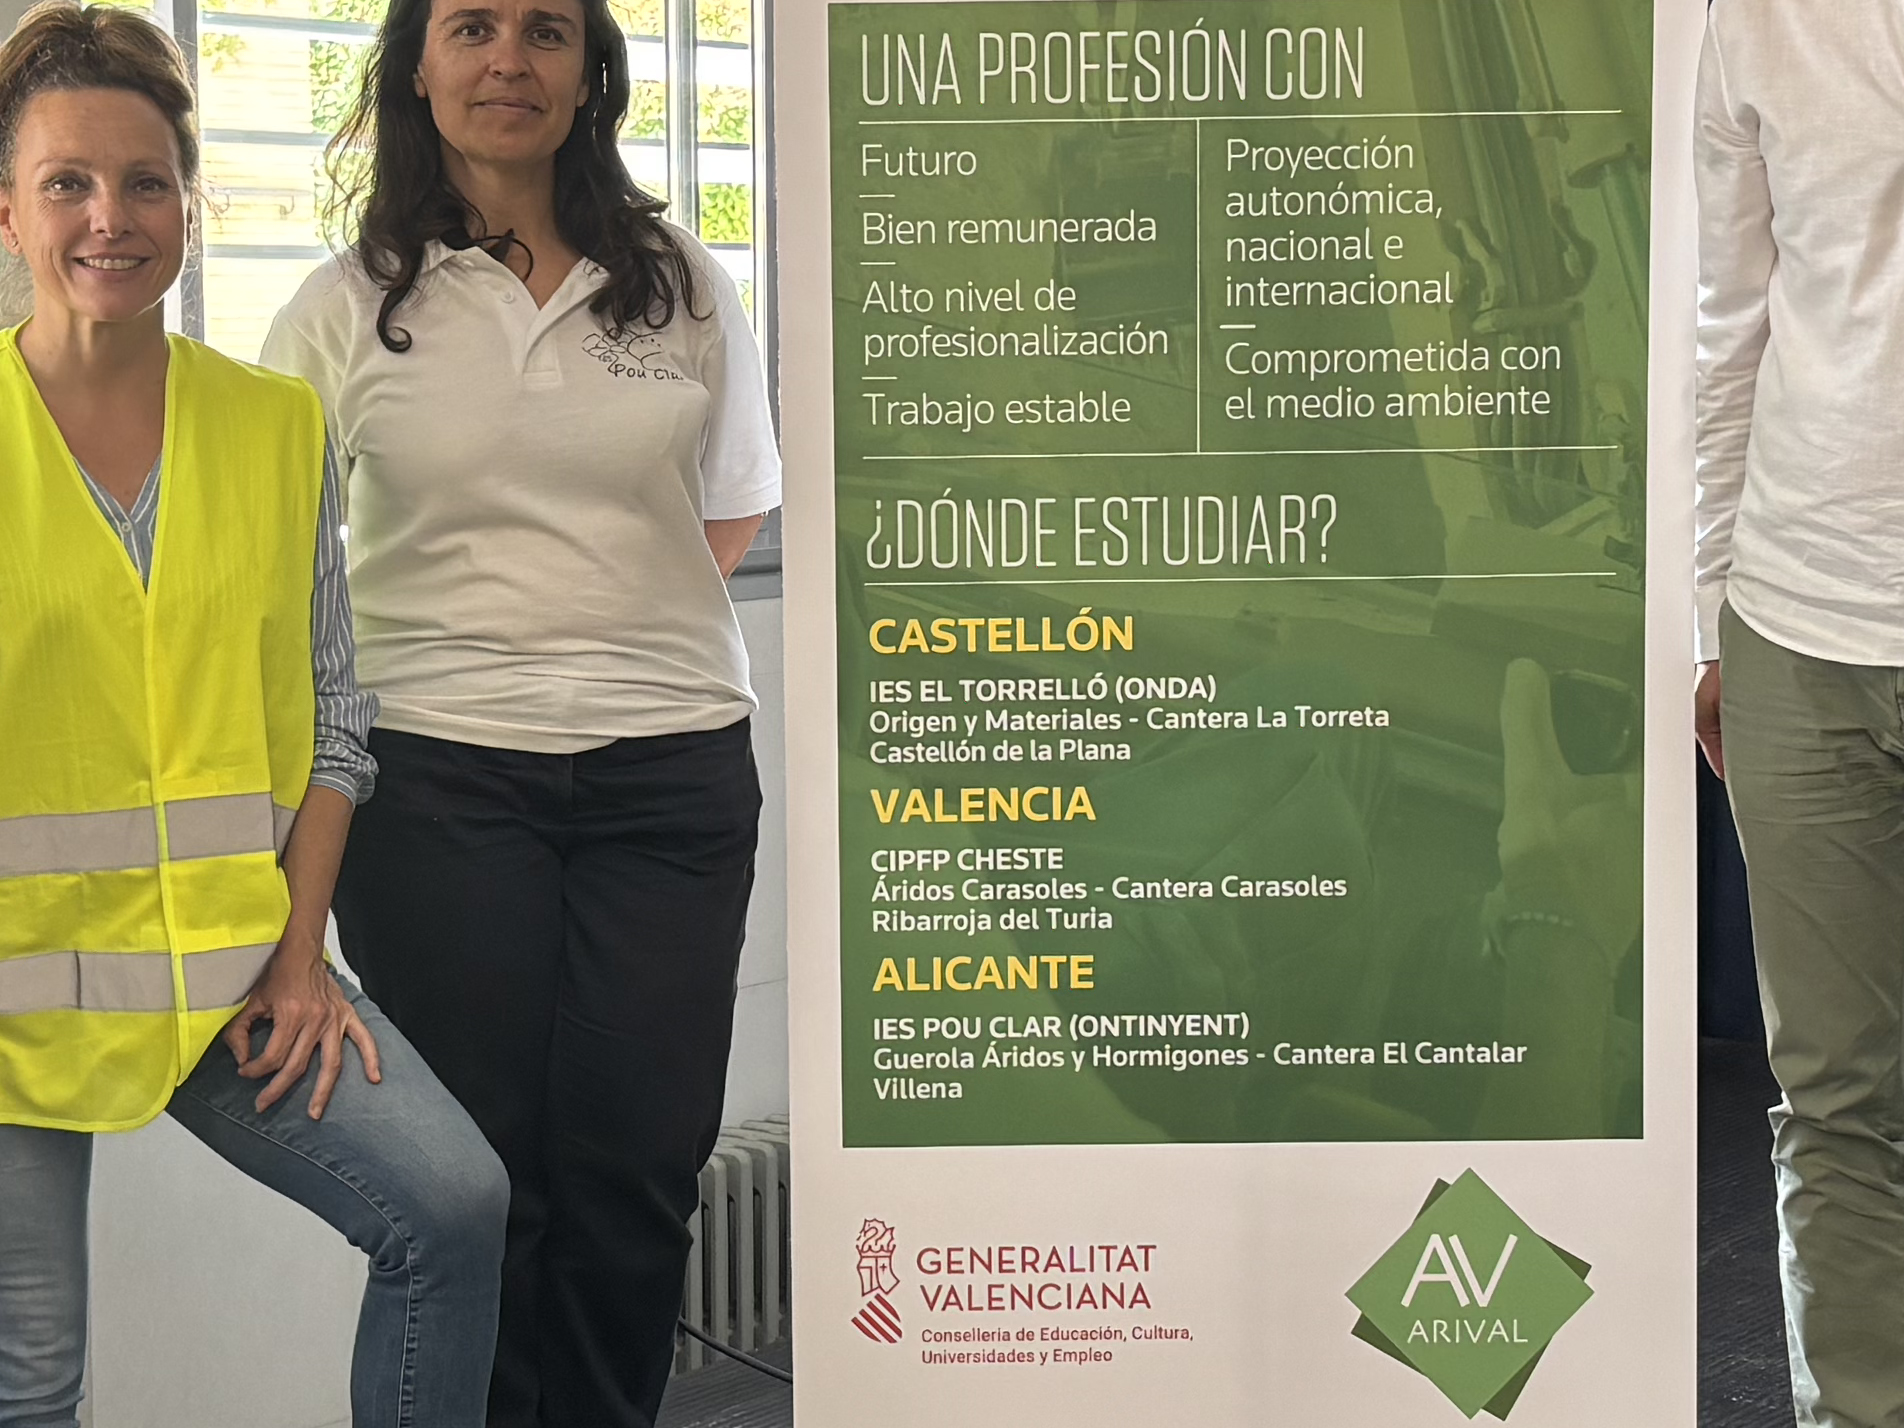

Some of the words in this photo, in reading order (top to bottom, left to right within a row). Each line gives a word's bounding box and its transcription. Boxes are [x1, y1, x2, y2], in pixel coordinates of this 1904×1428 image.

[863, 33, 961, 105] UNA
[980, 18, 1245, 103] PROFESIÓN
[1266, 27, 1362, 99] CON
[863, 144, 976, 176] Futuro
[1228, 135, 1413, 178] Proyección
[1226, 182, 1441, 218] autonómica,
[864, 213, 935, 244] Bien
[948, 209, 1156, 243] remunerada
[1227, 227, 1373, 261] nacional
[1385, 236, 1403, 259] e
[863, 281, 933, 313] Alto
[946, 279, 1024, 312] nivel
[1035, 279, 1075, 311] de
[1227, 271, 1453, 306] internacional
[865, 322, 1167, 360] profesionalización
[1226, 339, 1489, 381] Comprometida
[1501, 346, 1560, 370] con
[863, 393, 994, 432] Trabajo
[1006, 391, 1130, 423] estable
[1226, 387, 1255, 419] el
[1268, 386, 1374, 418] medio
[1386, 384, 1550, 417] ambiente
[867, 488, 1056, 568] ¿DÓNDE
[1075, 494, 1336, 565] ESTUDIAR?
[870, 607, 1132, 653] CASTELLÓN
[871, 681, 911, 702] IES
[921, 680, 952, 702] EL
[959, 672, 1107, 701] TORRELLÓ
[1116, 675, 1216, 703] (ONDA)
[870, 710, 956, 737] Origen
[964, 716, 977, 736] y
[986, 708, 1121, 731] Materiales
[1147, 707, 1248, 729] Cantera
[1257, 706, 1286, 727] La
[1295, 706, 1389, 727] Torreta
[871, 739, 985, 763] Castellón
[993, 740, 1023, 761] de
[1030, 739, 1052, 760] la
[1060, 739, 1130, 760] Plana
[870, 787, 1096, 823] VALENCIA
[872, 850, 950, 872] CIPFP
[957, 848, 1063, 870] CHESTE
[872, 875, 954, 901] Áridos
[962, 878, 1087, 900] Carasoles
[1112, 877, 1212, 898] Cantera
[1221, 875, 1346, 897] Carasoles
[873, 909, 991, 936] Ribarroja
[1000, 908, 1039, 930] del
[1046, 907, 1112, 929] Turia
[873, 955, 1093, 991] ALICANTE
[874, 1018, 915, 1040] IES
[924, 1017, 981, 1039] POU
[990, 1016, 1061, 1038] CLAR
[1070, 1012, 1249, 1041] (ONTINYENT)
[874, 1047, 974, 1069] Guerola
[982, 1041, 1064, 1068] Áridos
[1071, 1051, 1085, 1072] y
[1093, 1044, 1248, 1071] Hormigones
[1274, 1043, 1374, 1065] Cantera
[1384, 1042, 1407, 1063] El
[1415, 1042, 1527, 1063] Cantalar
[874, 1078, 962, 1099] Villena
[917, 1245, 1156, 1274] GENERALITAT
[920, 1283, 1151, 1311] VALENCIANA
[922, 1328, 1010, 1342] Conselleria
[1016, 1328, 1034, 1341] de
[1040, 1326, 1126, 1342] Educación,
[1132, 1325, 1193, 1341] Cultura,
[1407, 1319, 1528, 1343] ARIVAL
[922, 1349, 1034, 1364] Universidades
[1040, 1352, 1048, 1366] y
[1053, 1347, 1112, 1365] Empleo
